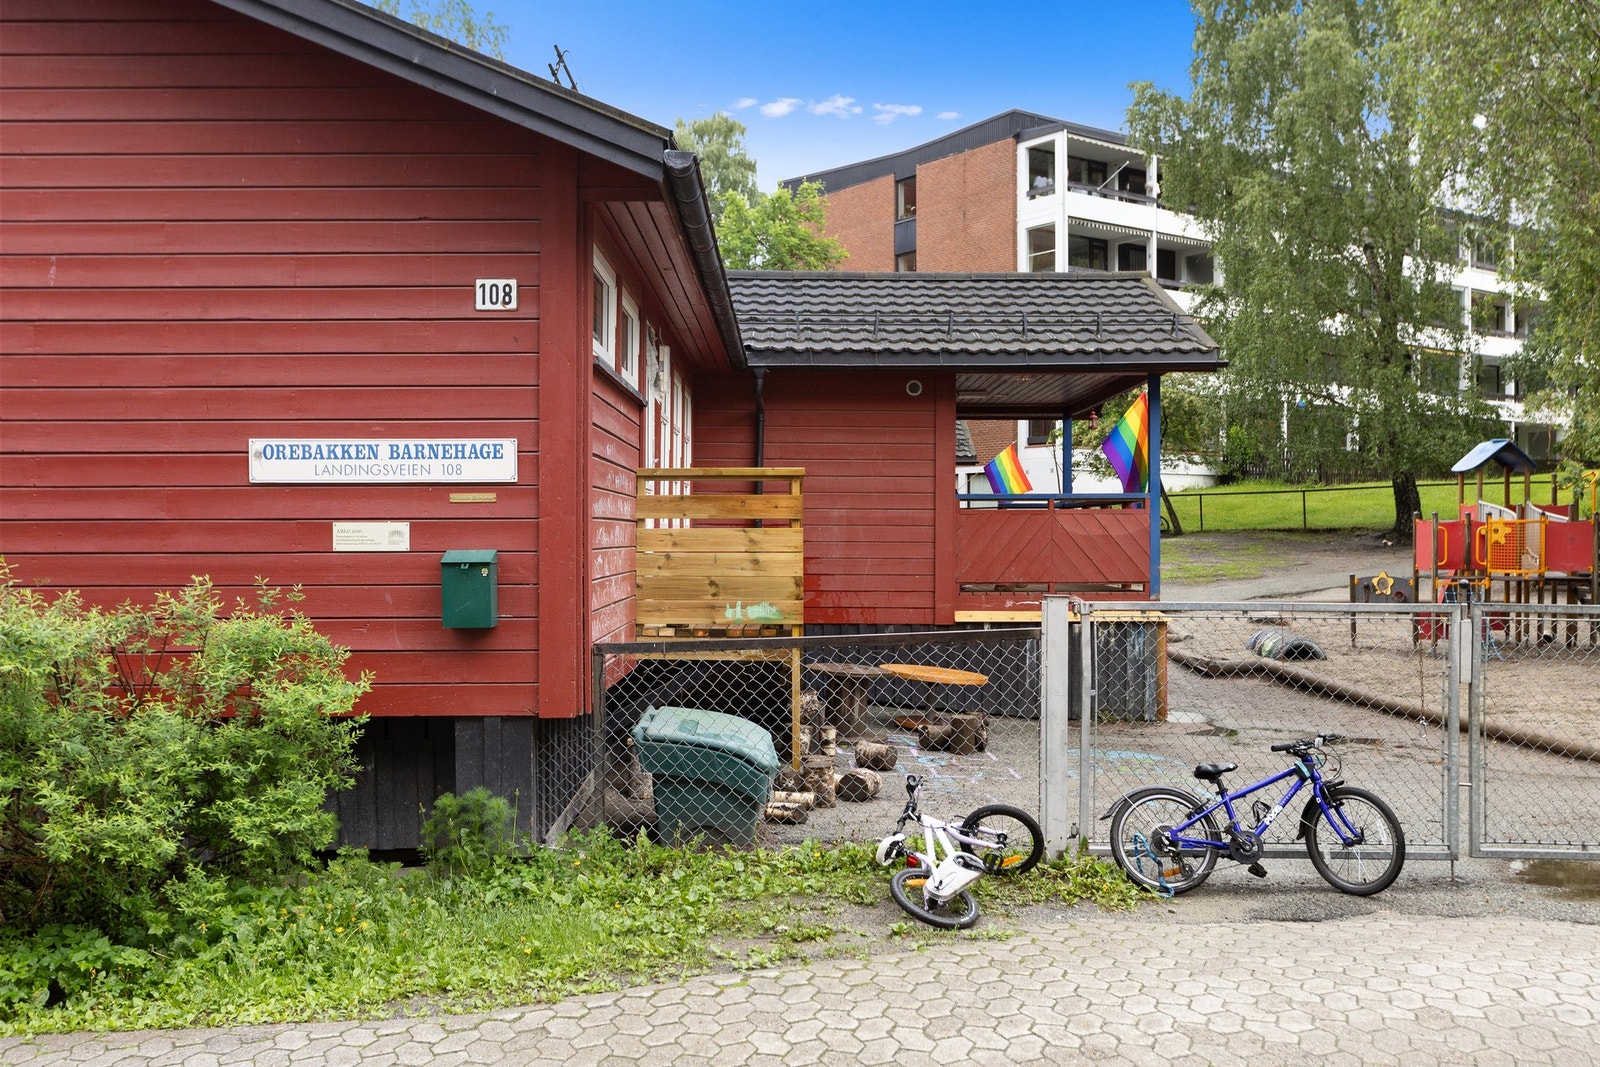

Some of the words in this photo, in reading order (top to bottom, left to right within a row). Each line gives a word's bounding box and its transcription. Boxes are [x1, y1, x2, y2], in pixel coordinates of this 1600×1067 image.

[478, 282, 513, 306] 108
[262, 443, 380, 461] OREBAKKEN
[389, 443, 504, 460] BARNEHAGE
[314, 463, 431, 476] LANDINGSVEIEN
[441, 463, 463, 476] 108
